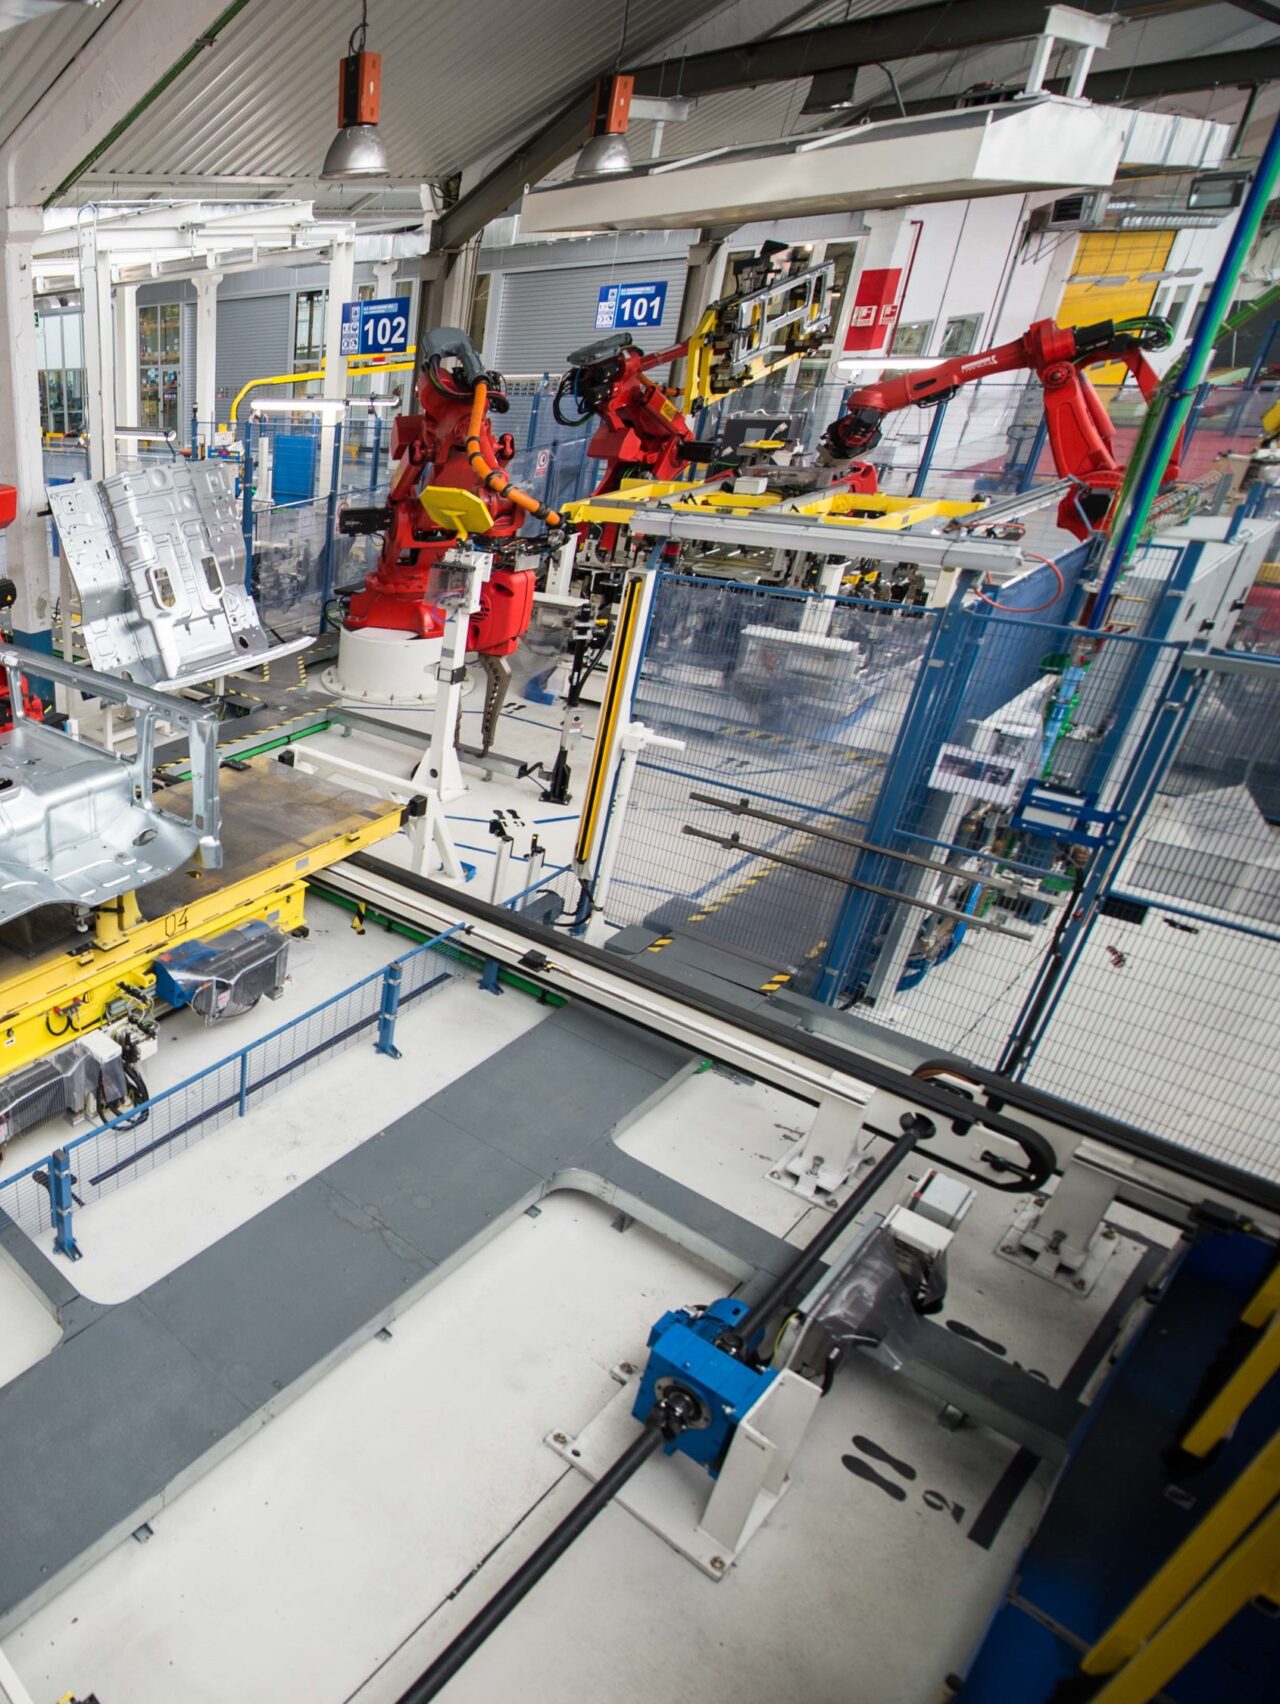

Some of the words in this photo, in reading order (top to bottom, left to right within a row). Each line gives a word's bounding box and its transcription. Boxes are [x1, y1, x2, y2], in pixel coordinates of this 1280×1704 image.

[620, 296, 661, 321] 101
[363, 316, 406, 346] 102
[164, 907, 190, 938] 04
